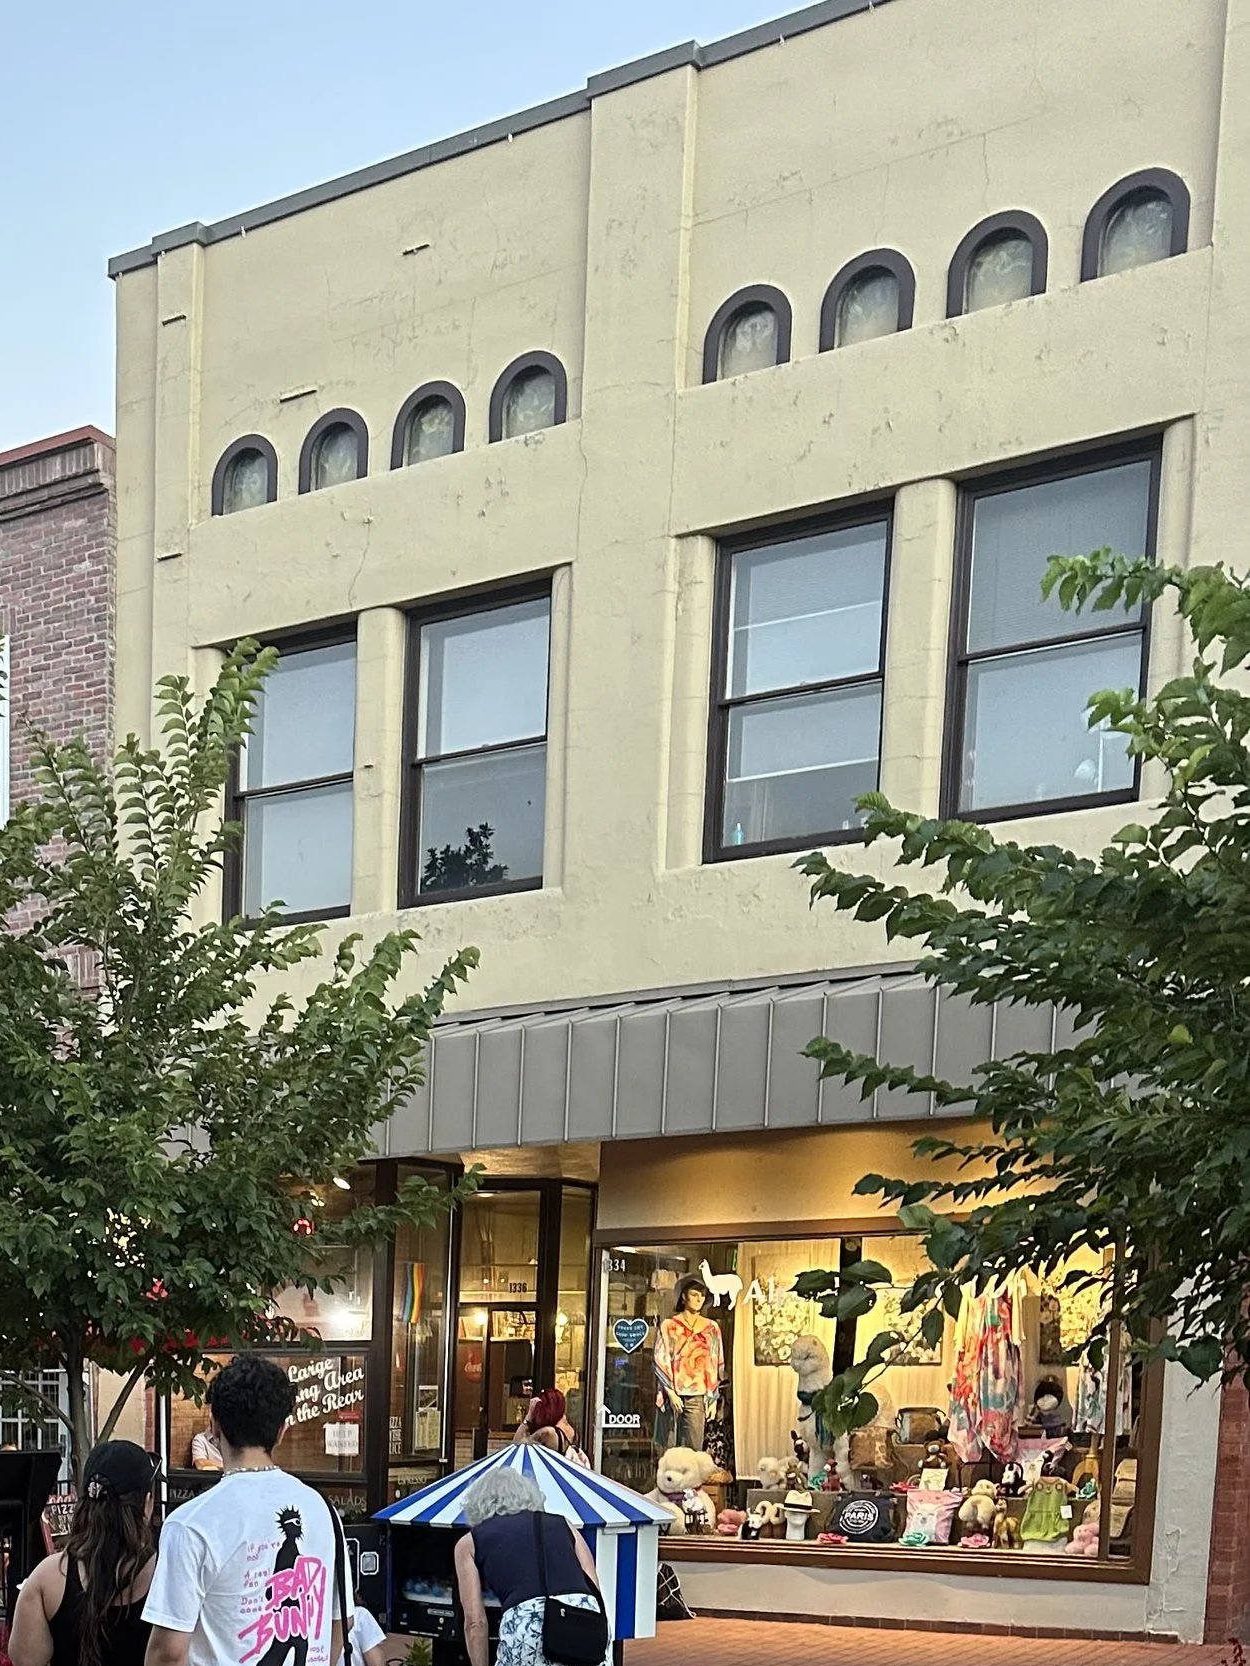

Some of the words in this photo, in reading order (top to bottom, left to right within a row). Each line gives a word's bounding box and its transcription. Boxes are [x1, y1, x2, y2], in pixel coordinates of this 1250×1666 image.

[509, 1283, 527, 1293] 1336
[287, 1359, 333, 1383] Large
[324, 1367, 365, 1391] Area
[296, 1402, 321, 1423] the
[322, 1389, 365, 1413] Rear
[389, 1415, 402, 1429] IZZA
[609, 1413, 641, 1424] DOOR
[388, 1442, 402, 1455] LICE
[51, 1503, 77, 1515] PIZZ
[844, 1512, 874, 1521] PARIS
[265, 1556, 322, 1611] BAD
